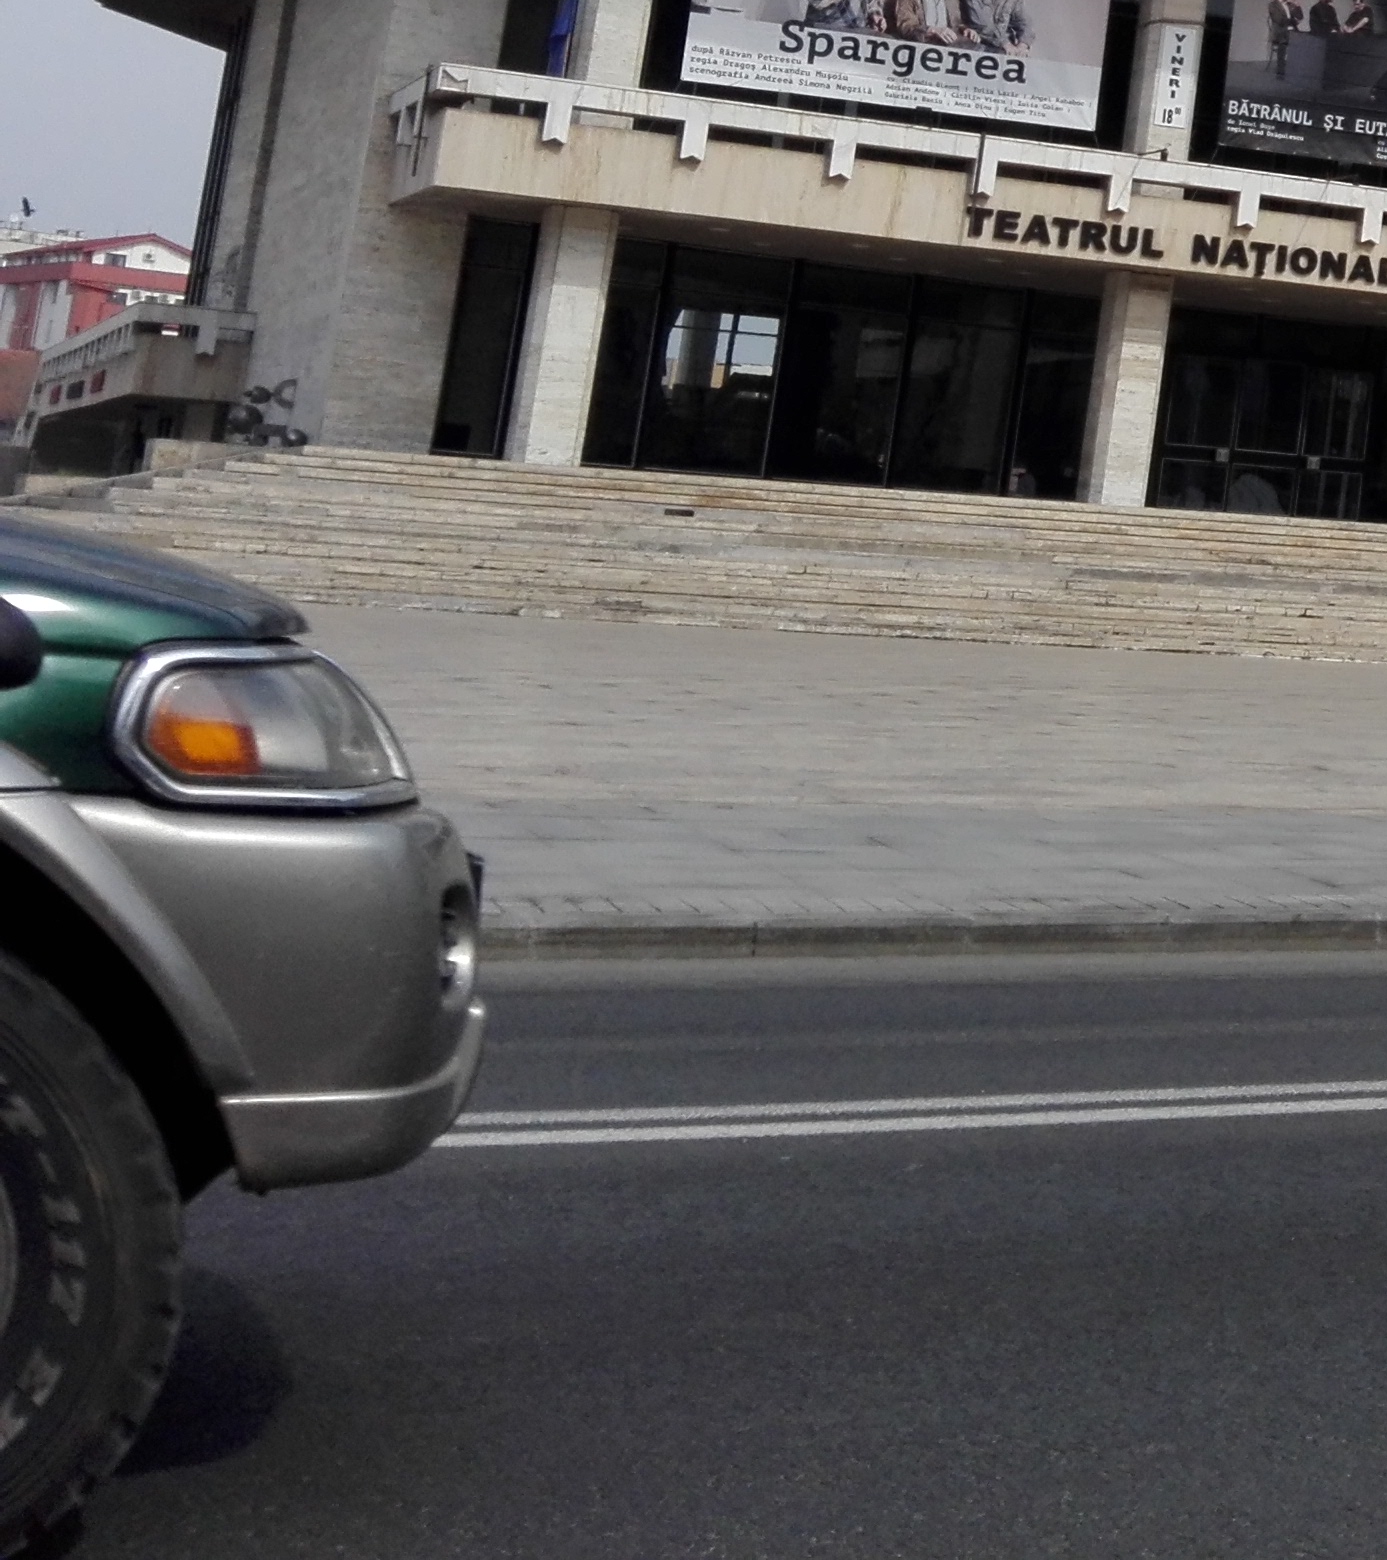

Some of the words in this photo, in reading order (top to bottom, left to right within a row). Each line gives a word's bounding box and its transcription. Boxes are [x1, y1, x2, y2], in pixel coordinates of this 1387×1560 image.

[690, 56, 718, 66] regia
[723, 60, 756, 71] Dragoș
[761, 65, 811, 76] Alexandru
[691, 45, 714, 54] după
[719, 49, 753, 59] Răzvan
[758, 54, 802, 65] Petrescu
[779, 19, 1027, 85] Spargerea
[1169, 33, 1187, 98] VINERI
[689, 66, 749, 80] scenografia
[754, 74, 794, 85] Andreea
[798, 80, 831, 89] Simona
[1228, 99, 1313, 126] BĂTRÂNUL
[1324, 114, 1345, 132] ȘI
[1227, 126, 1246, 134] regia
[1249, 128, 1264, 136] Vlad
[965, 206, 1164, 259] TEATRUL
